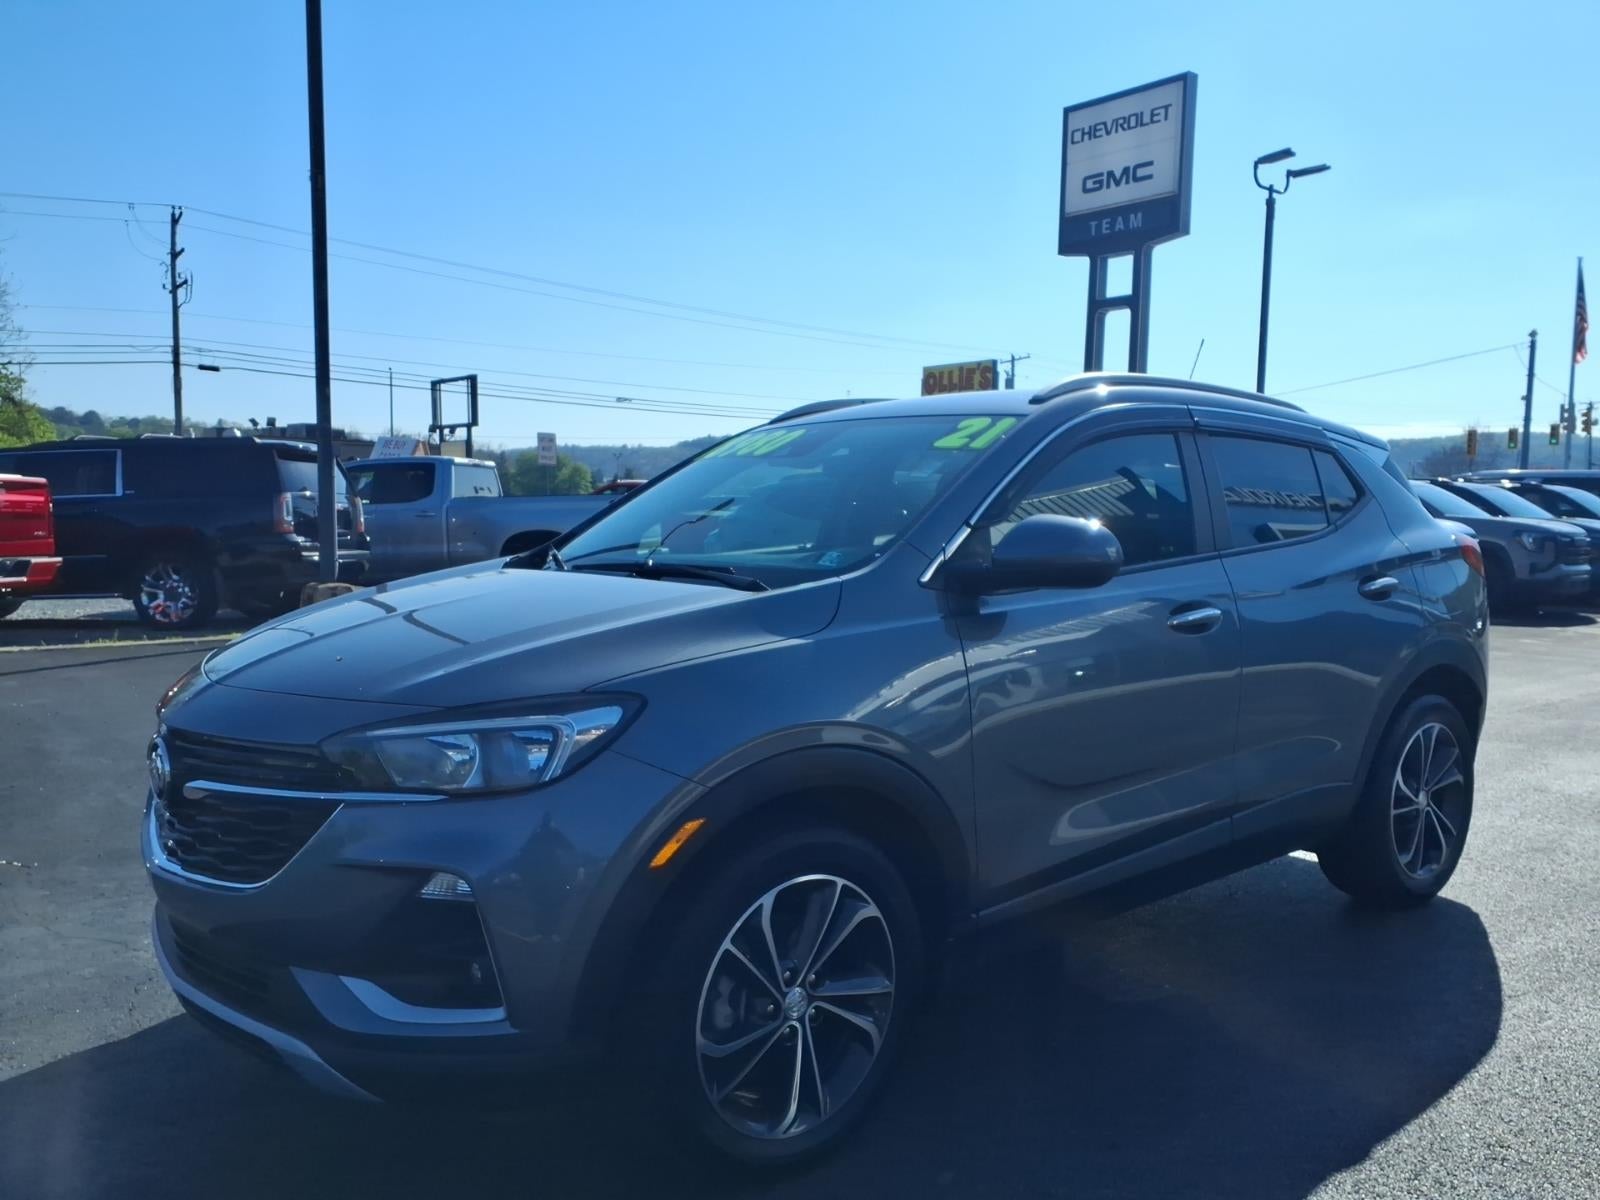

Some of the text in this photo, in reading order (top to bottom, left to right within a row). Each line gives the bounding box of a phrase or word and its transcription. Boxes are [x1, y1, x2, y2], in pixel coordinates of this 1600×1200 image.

[1072, 104, 1172, 144] CHEVROLET
[1082, 160, 1154, 194] GMC
[1089, 212, 1143, 236] TEAM
[925, 362, 992, 395] OLLIE'S
[934, 417, 1016, 448] 21
